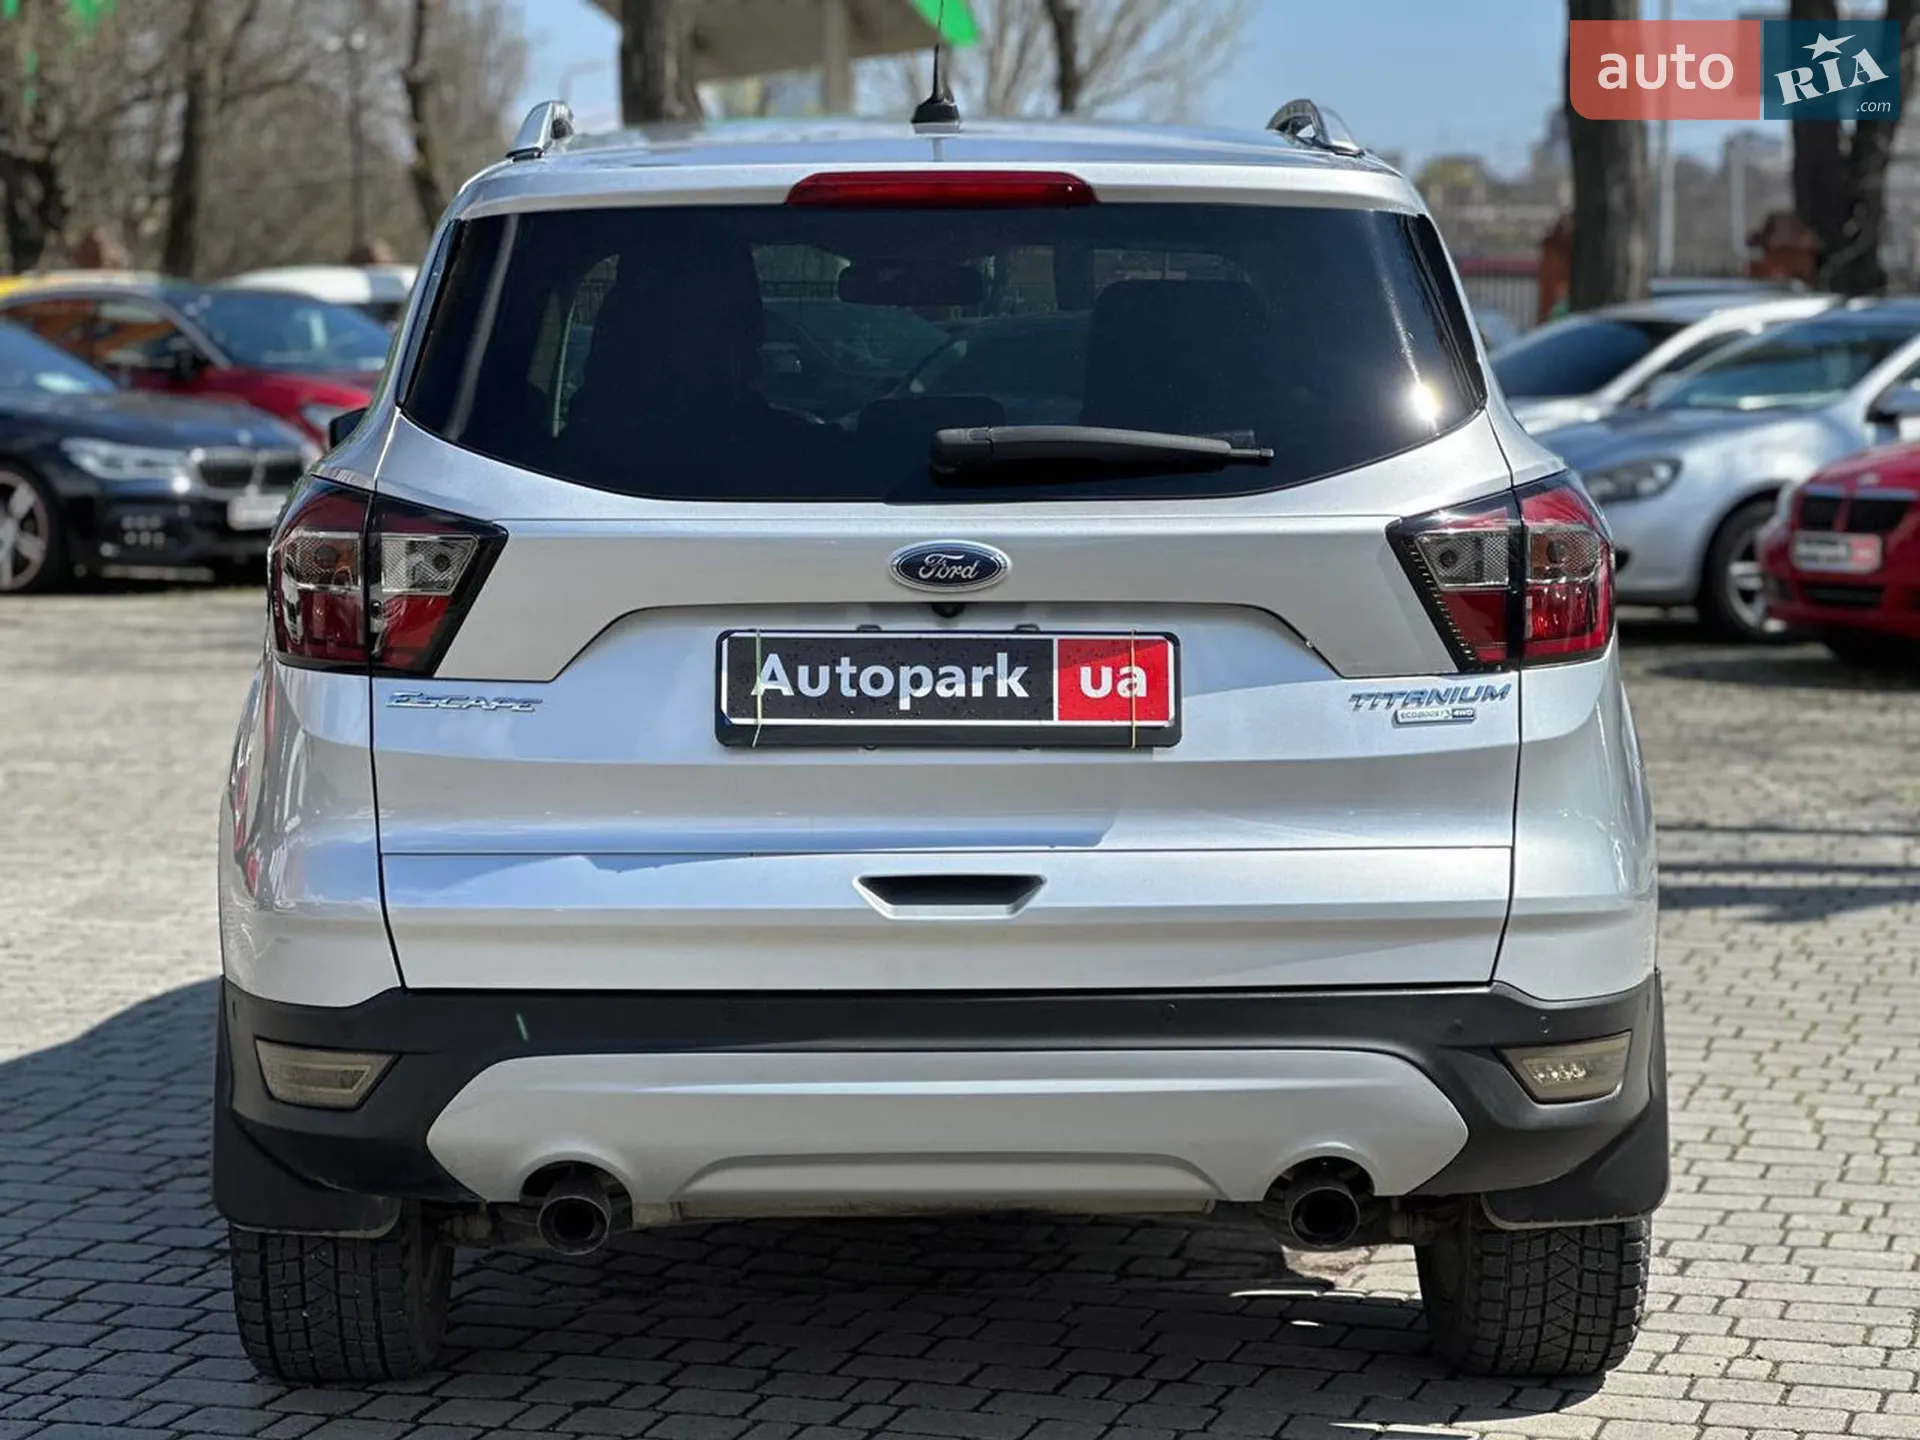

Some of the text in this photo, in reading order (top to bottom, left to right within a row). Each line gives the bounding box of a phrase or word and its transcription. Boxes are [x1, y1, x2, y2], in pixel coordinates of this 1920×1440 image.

[919, 553, 980, 579] Ford
[751, 652, 1147, 710] Autopark ua
[1349, 683, 1512, 711] TITANIUM
